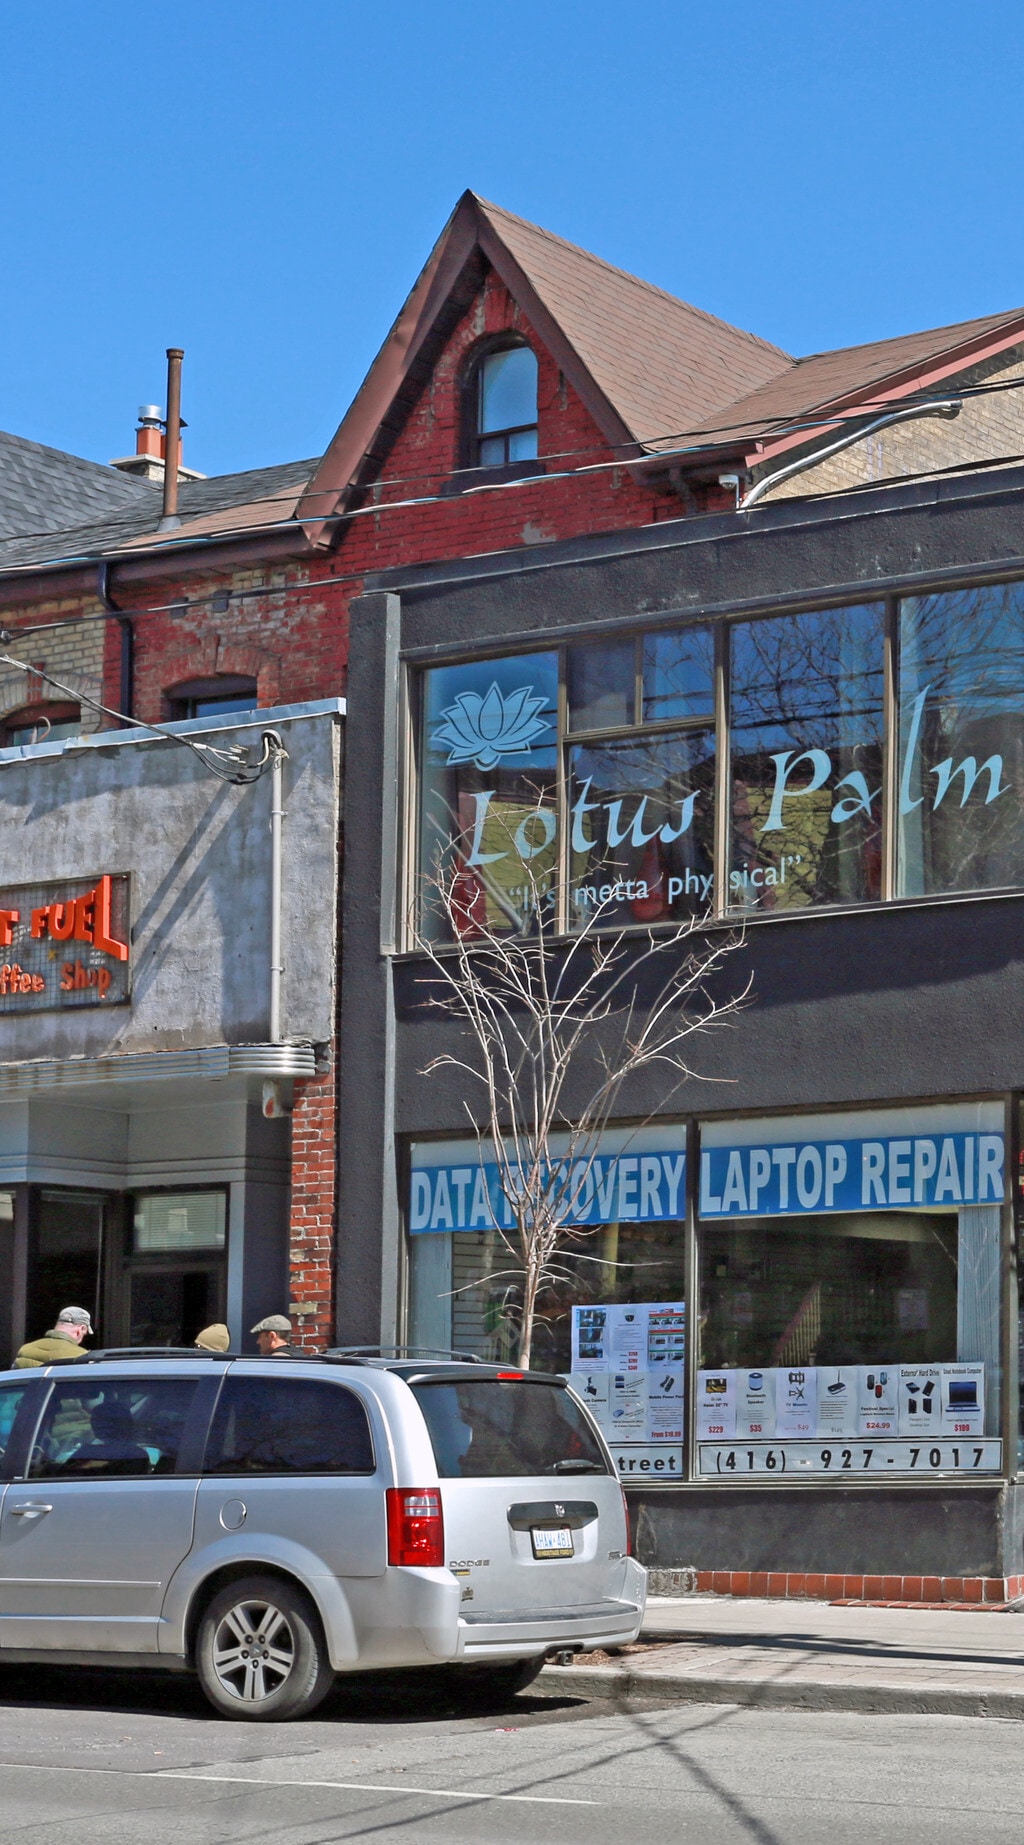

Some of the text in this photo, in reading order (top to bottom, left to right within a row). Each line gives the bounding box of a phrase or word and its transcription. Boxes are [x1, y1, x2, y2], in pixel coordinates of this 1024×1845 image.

[465, 685, 1012, 867] Lotus Palm
[574, 877, 650, 905] metta
[30, 875, 128, 961] FUEL
[0, 960, 111, 999] ffee Shop
[702, 1141, 848, 1212] LAPTOP
[861, 1135, 1005, 1204] REPAIR
[410, 1167, 490, 1230] DATA
[749, 1424, 762, 1432] $35
[617, 1455, 676, 1471] treet
[449, 1559, 490, 1567] DODGE
